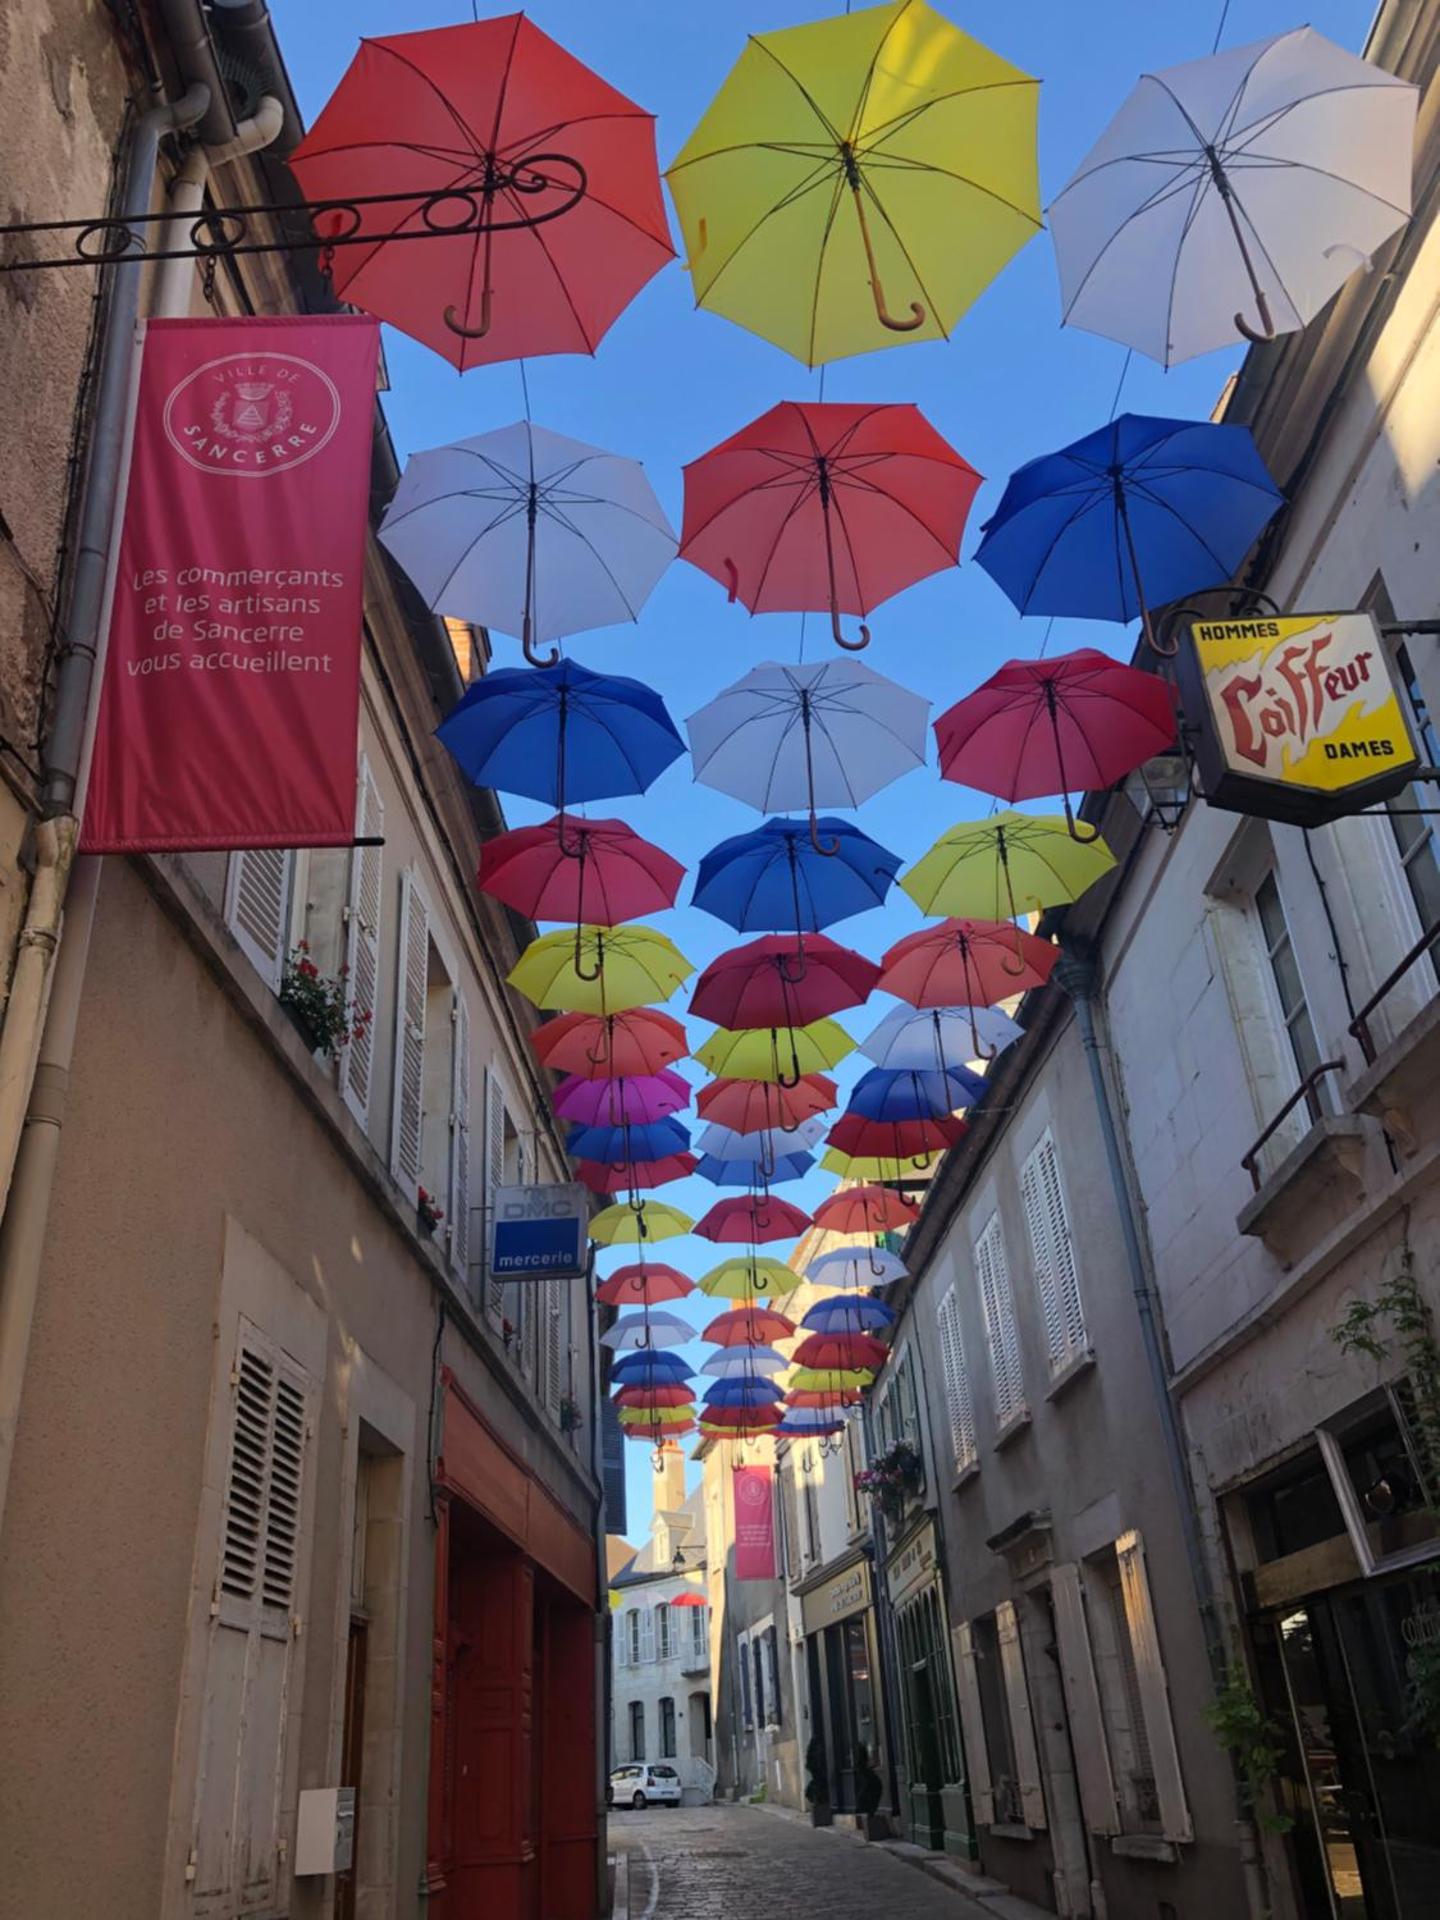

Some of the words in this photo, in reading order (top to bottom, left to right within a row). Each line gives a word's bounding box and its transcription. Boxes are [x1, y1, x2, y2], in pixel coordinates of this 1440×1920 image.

[213, 365, 266, 383] VILLE
[276, 367, 301, 384] DE
[183, 422, 318, 465] SANCERRE
[133, 568, 168, 592] Les
[177, 567, 344, 589] commerçants
[145, 594, 167, 614] et
[176, 593, 210, 613] les
[218, 593, 321, 615] artisans
[153, 620, 184, 641] de
[192, 620, 304, 643] Sancerre
[1200, 622, 1280, 641] HOMMES
[127, 653, 181, 676] vous
[189, 651, 332, 673] accueillent
[1324, 740, 1394, 760] DAMES
[503, 1201, 572, 1219] DMC
[499, 1251, 573, 1267] mercerie
